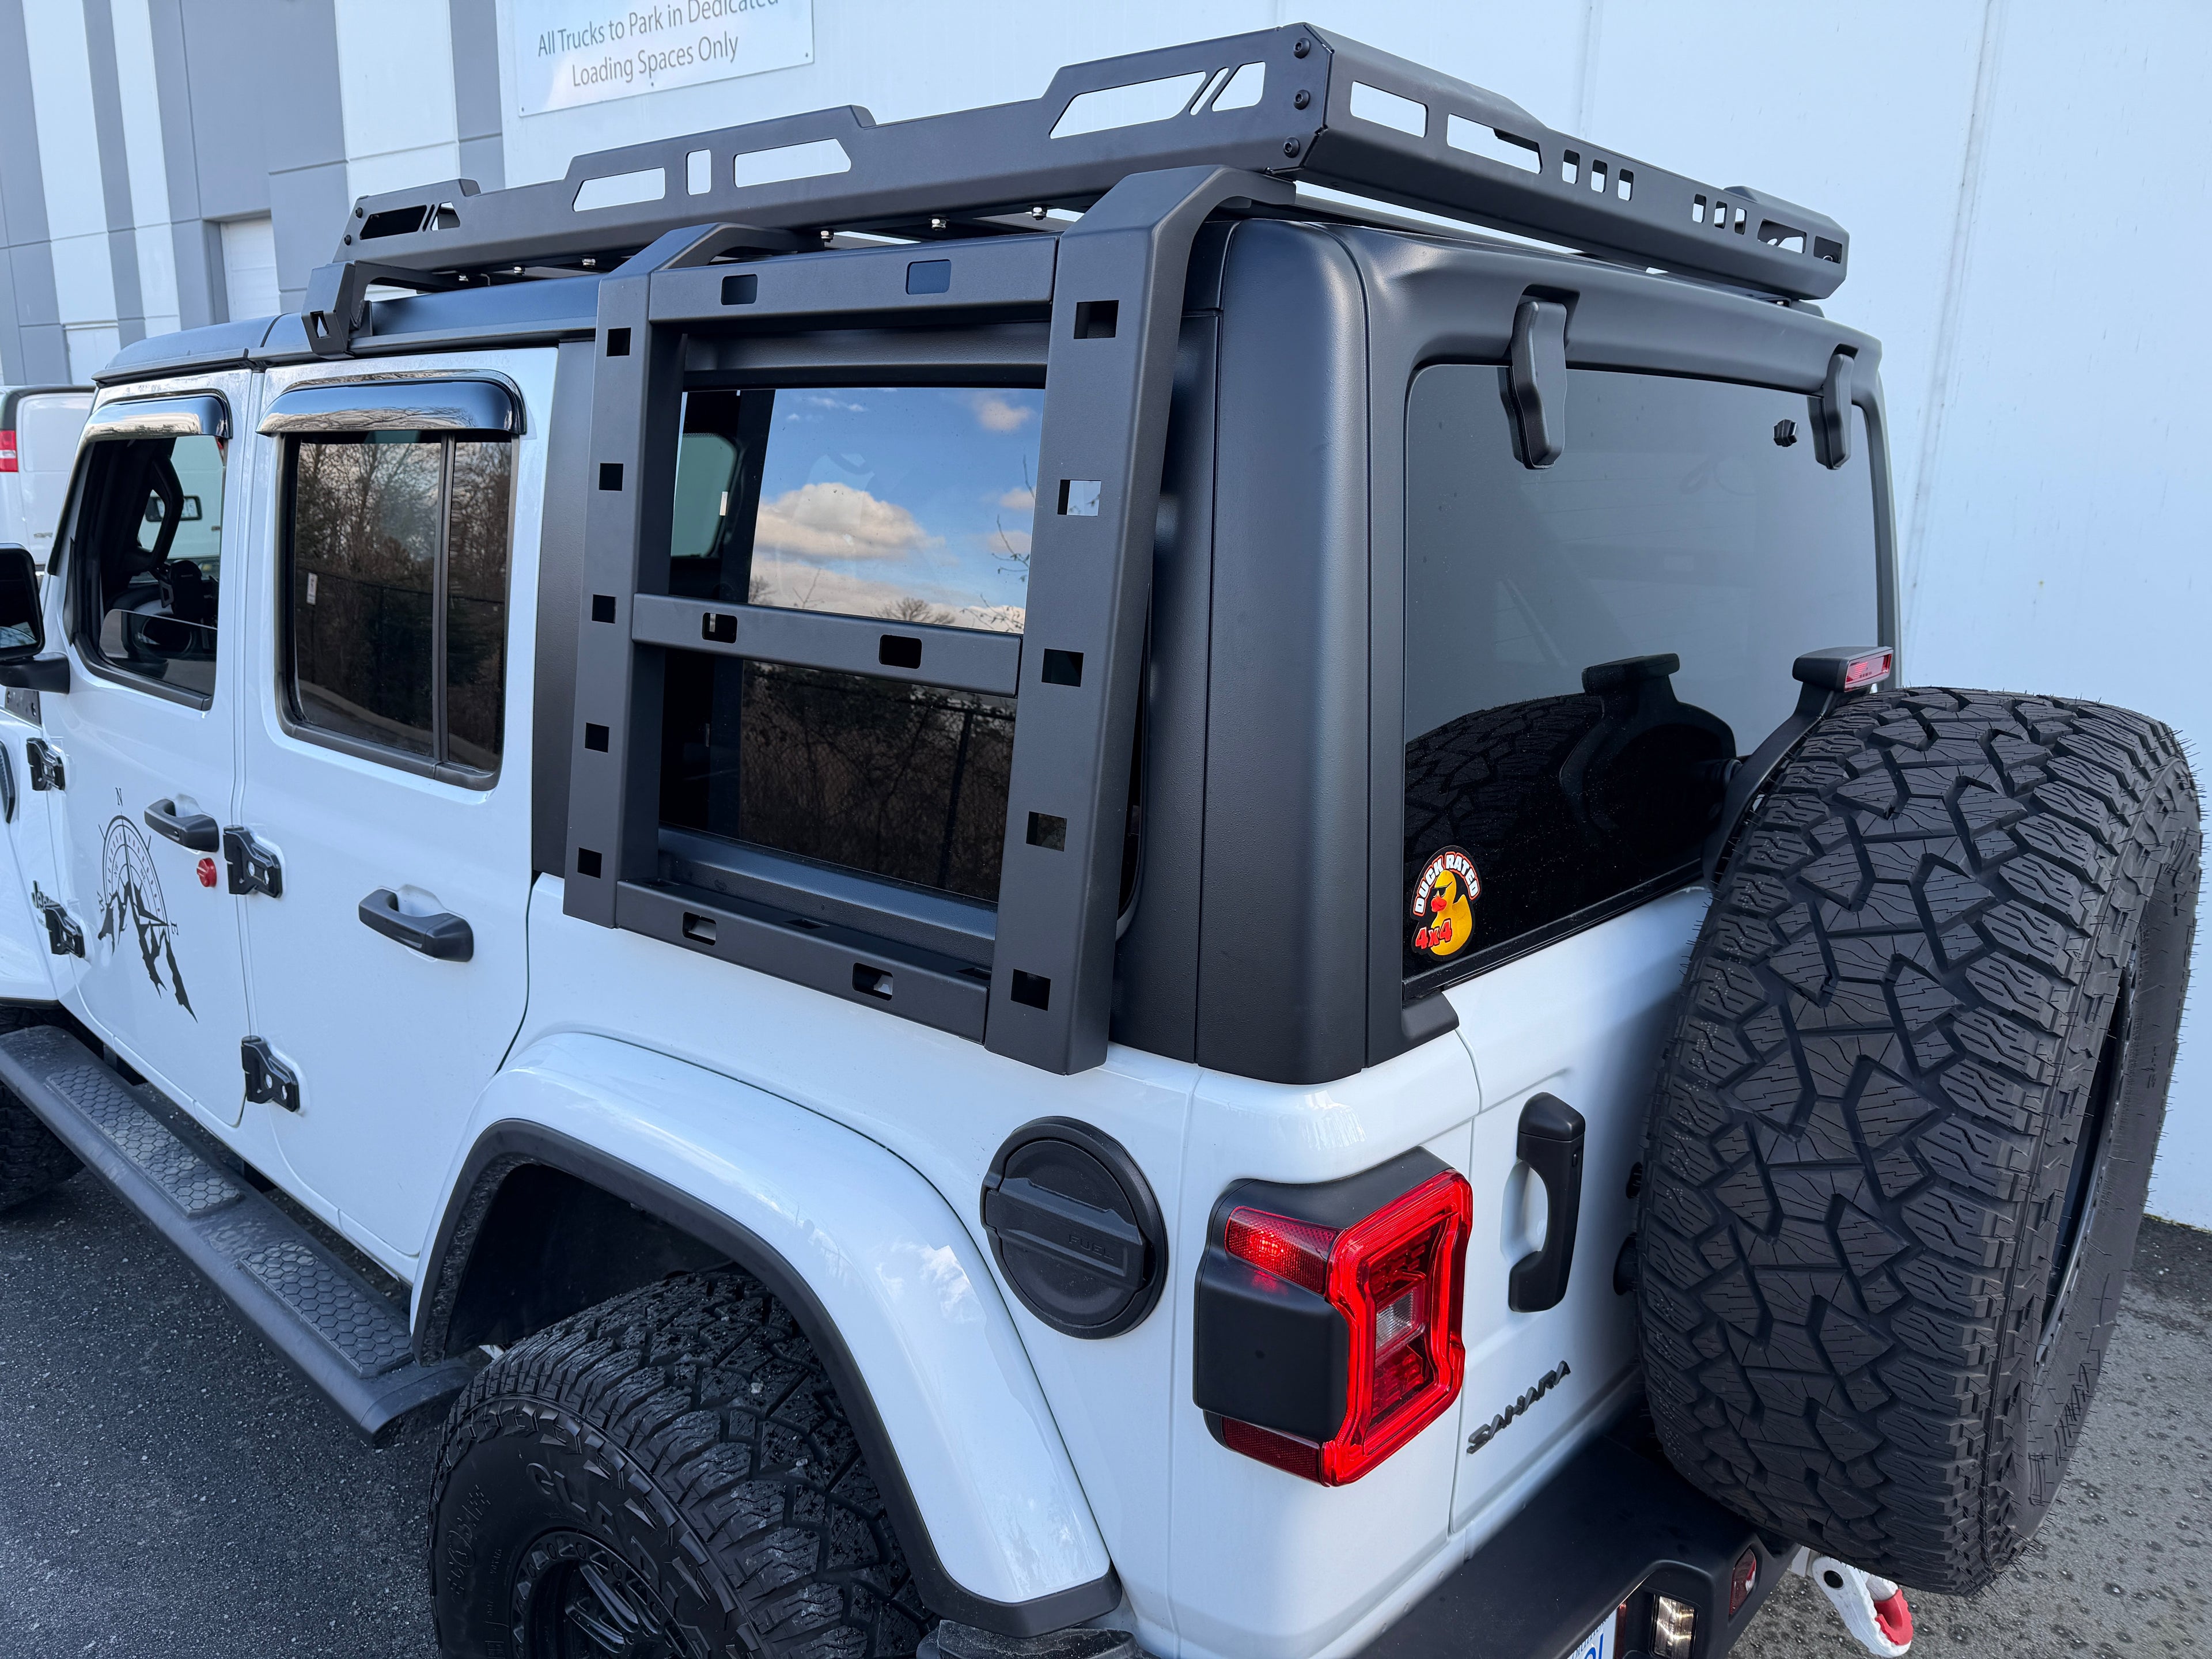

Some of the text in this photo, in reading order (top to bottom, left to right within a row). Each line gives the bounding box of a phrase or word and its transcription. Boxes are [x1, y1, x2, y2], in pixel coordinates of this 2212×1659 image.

[538, 30, 555, 56] All
[558, 21, 605, 52] Trucks
[609, 20, 624, 40] to
[629, 5, 664, 36] Park
[668, 4, 682, 28] in
[573, 31, 738, 86] Loading Spaces Only
[1414, 853, 1480, 915] DUCK RATED
[1069, 1234, 1114, 1261] FUEL
[1467, 1360, 1571, 1455] SAHARA
